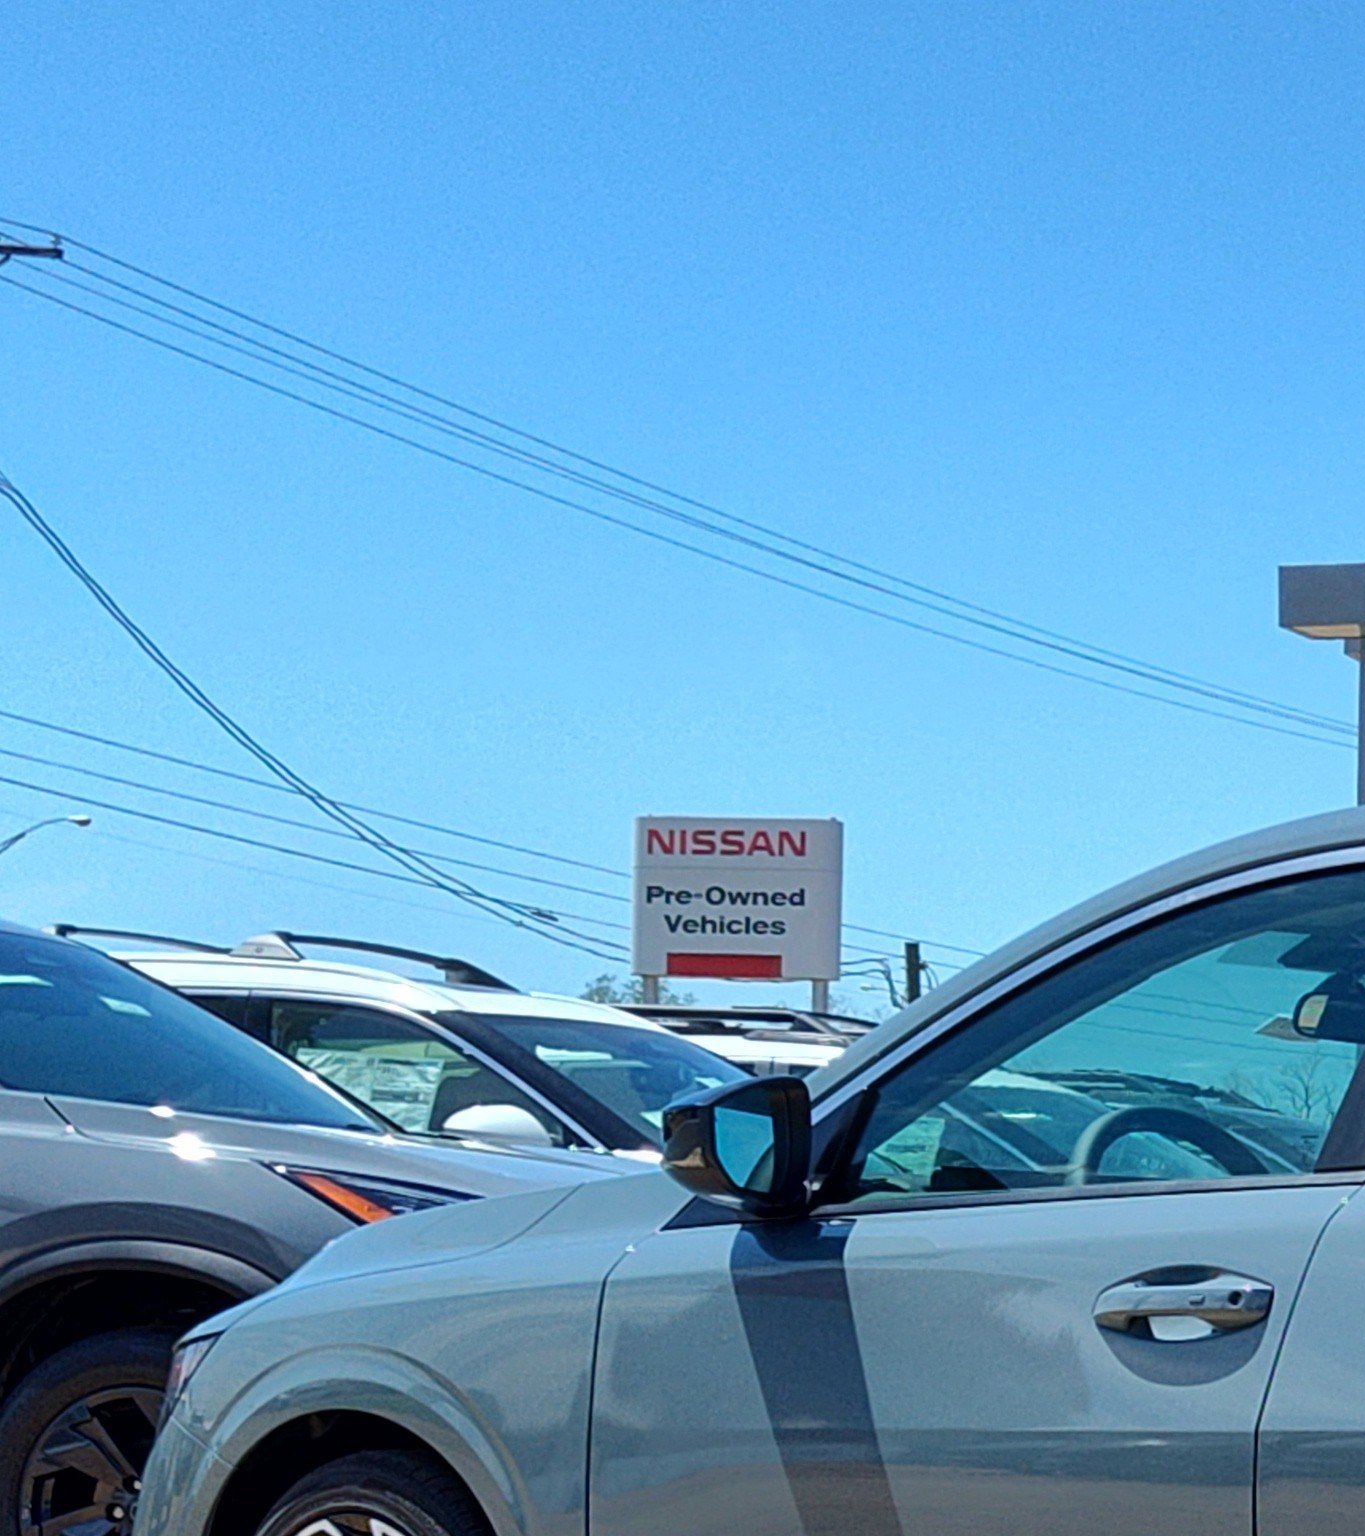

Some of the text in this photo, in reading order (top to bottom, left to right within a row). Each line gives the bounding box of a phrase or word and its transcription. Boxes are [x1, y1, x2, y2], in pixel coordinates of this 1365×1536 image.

[647, 828, 807, 858] NISSAN
[646, 885, 806, 907] Pre-Owned
[663, 914, 787, 936] Vehicles
